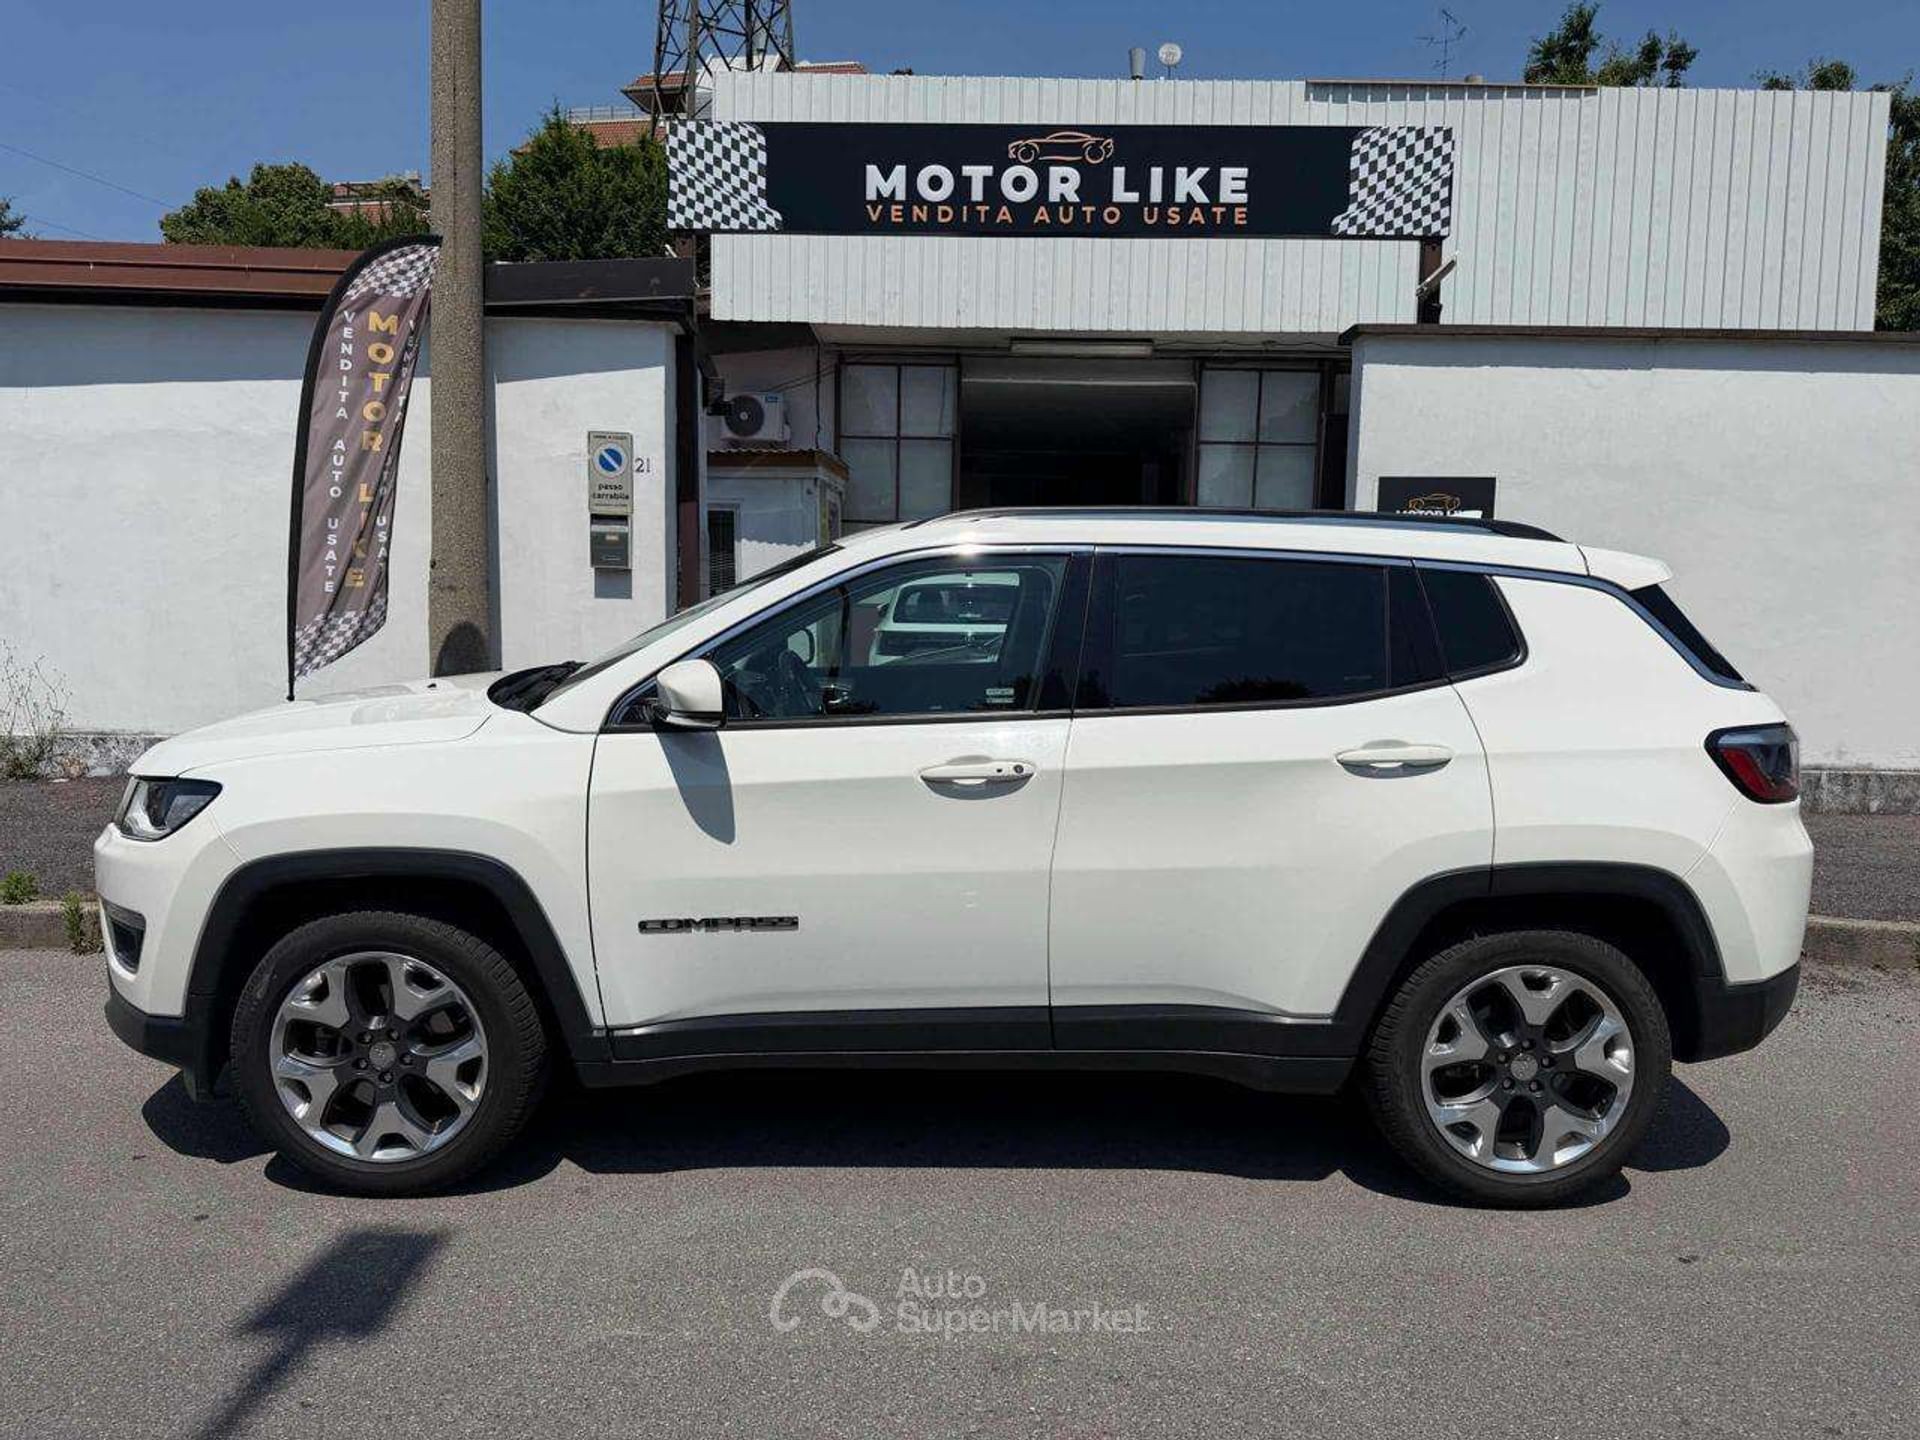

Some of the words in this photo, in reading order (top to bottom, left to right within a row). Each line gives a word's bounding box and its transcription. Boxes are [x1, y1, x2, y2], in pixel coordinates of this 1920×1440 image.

[865, 164, 1081, 203] MOTOR
[1112, 166, 1249, 204] LIKE
[865, 204, 1013, 224] VENDITA
[1034, 205, 1121, 225] AUTO
[1143, 206, 1249, 226] USATE
[336, 311, 356, 420] VENDITA
[362, 311, 399, 452] MOTOR
[329, 439, 346, 498] AUTO
[634, 457, 651, 473] 21
[598, 483, 624, 491] passo
[324, 517, 339, 593] USATE
[638, 916, 799, 934] COMPASS
